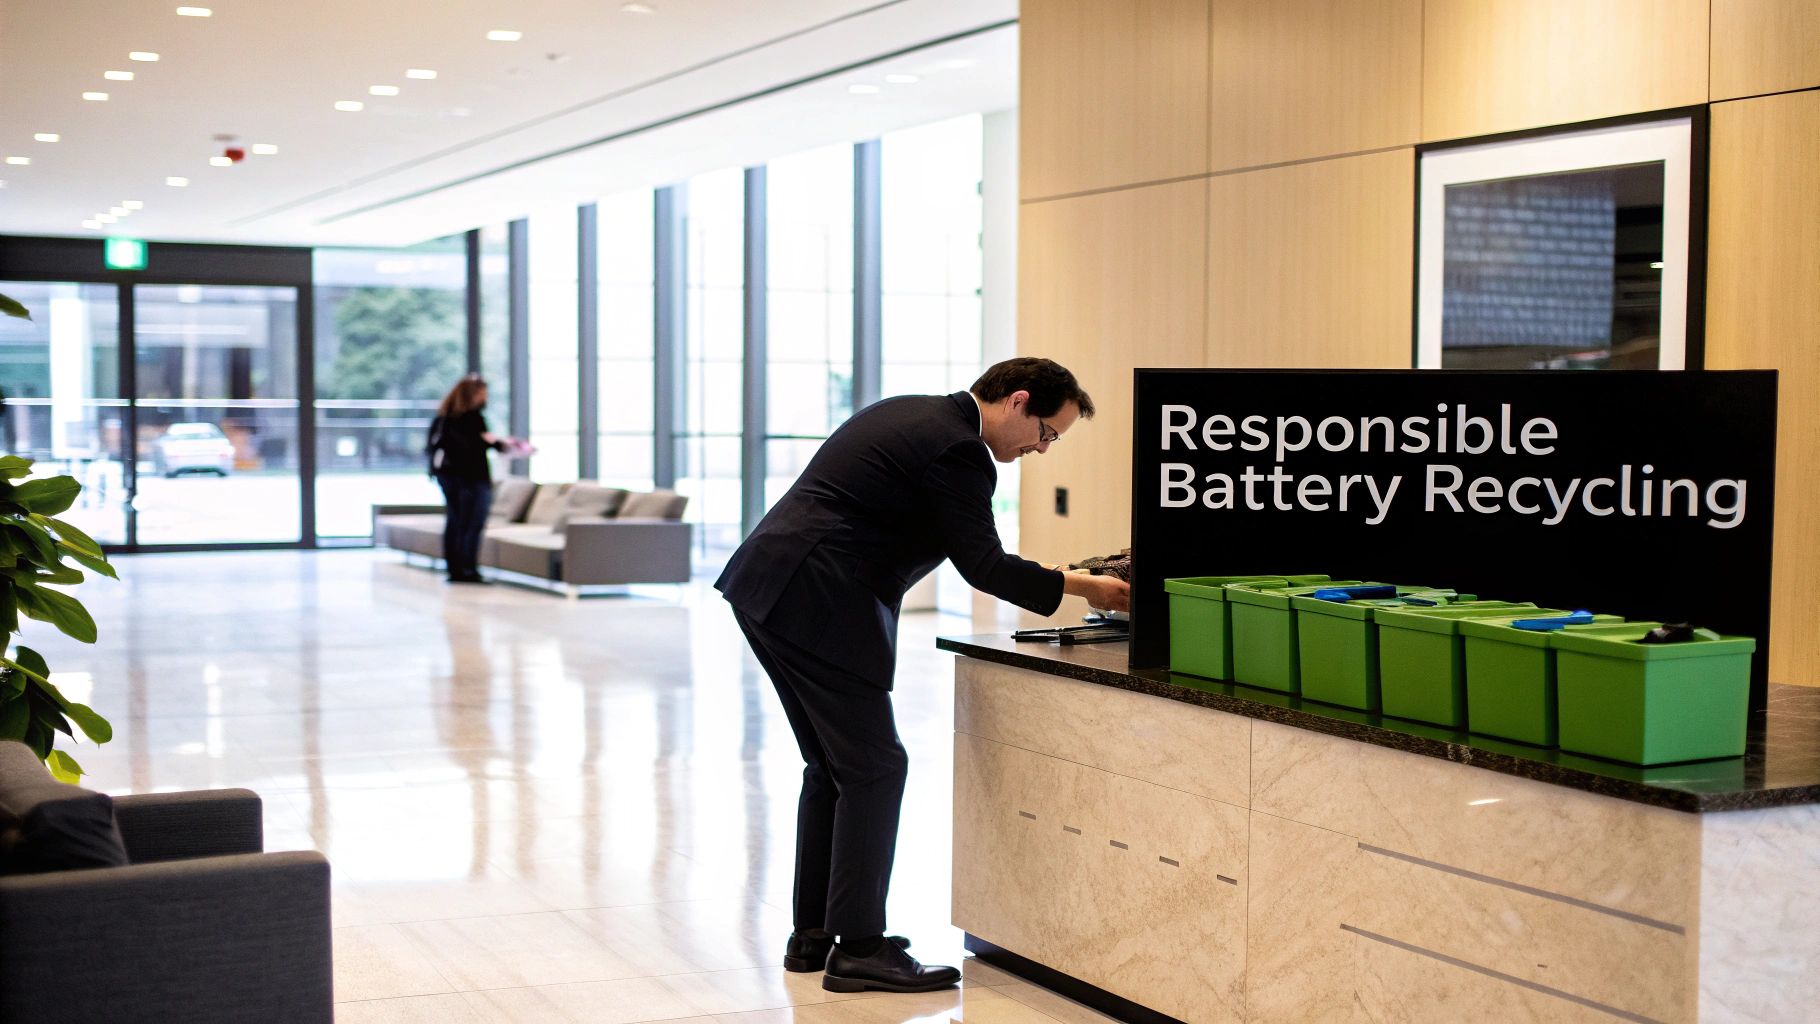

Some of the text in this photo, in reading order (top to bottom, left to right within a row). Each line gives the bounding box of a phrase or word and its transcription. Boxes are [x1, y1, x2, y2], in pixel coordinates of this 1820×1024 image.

[1160, 402, 1558, 463] Responsible
[1160, 462, 1747, 529] Battery Recycling
